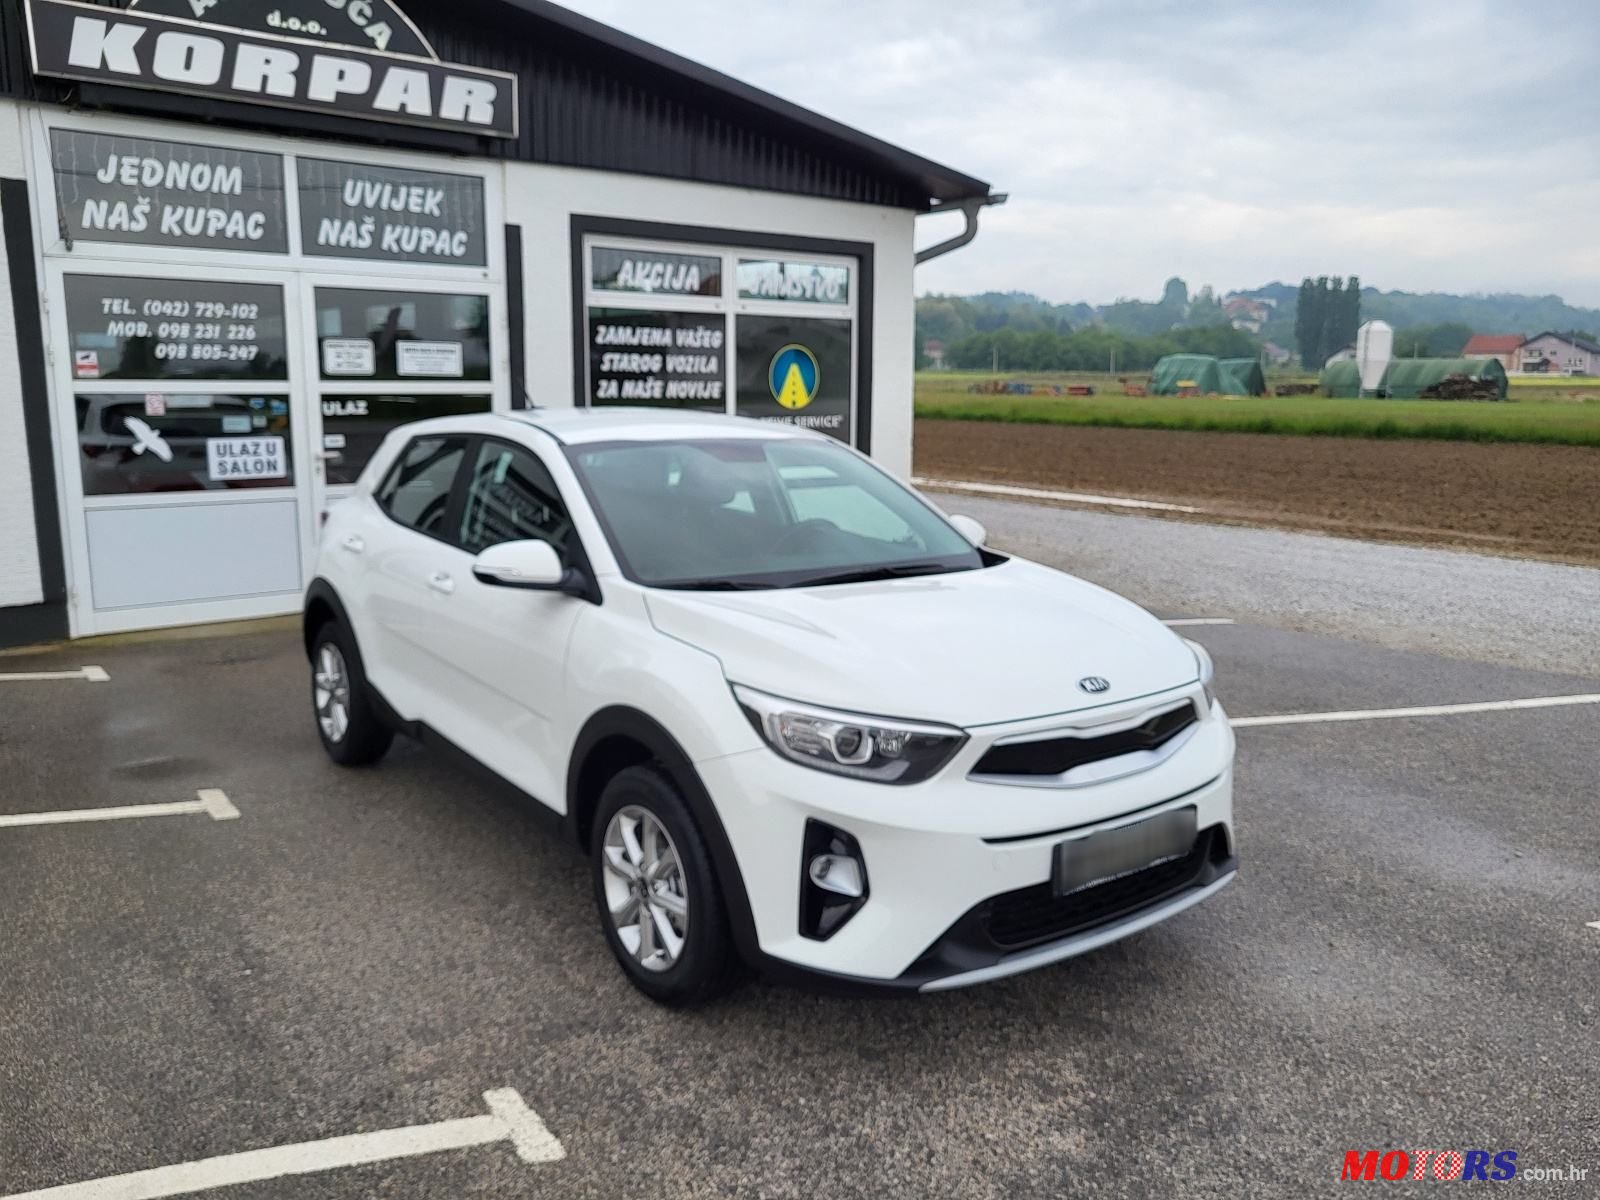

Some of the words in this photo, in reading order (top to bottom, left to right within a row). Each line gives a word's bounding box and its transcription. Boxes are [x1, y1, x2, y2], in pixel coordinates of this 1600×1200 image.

[266, 9, 327, 36] d.o.o.
[68, 16, 498, 125] KORPAR
[97, 154, 242, 195] JEDNOM
[343, 178, 444, 217] UVIJEK
[81, 195, 151, 232] NAŠ
[160, 204, 266, 240] KUPAC
[317, 215, 375, 249] NAŠ
[381, 224, 468, 257] KUPAC
[616, 259, 701, 292] AKCIJA
[101, 297, 136, 315] TEL.
[143, 299, 190, 318] (042)
[195, 301, 259, 320] 729-102
[106, 320, 152, 338] MOB.
[158, 321, 190, 339] 098
[595, 324, 673, 347] ZAMJENA
[675, 325, 723, 349] VAŠEG
[155, 342, 188, 360] 098
[600, 352, 663, 374] STAROG
[665, 354, 718, 374] VOZILA
[596, 379, 619, 399] ZA
[620, 375, 664, 399] NAŠE
[665, 380, 722, 399] NOVIJE
[322, 399, 369, 416] ULAZ
[216, 441, 261, 457] ULAZ
[265, 441, 277, 455] U
[217, 459, 278, 475] SALON
